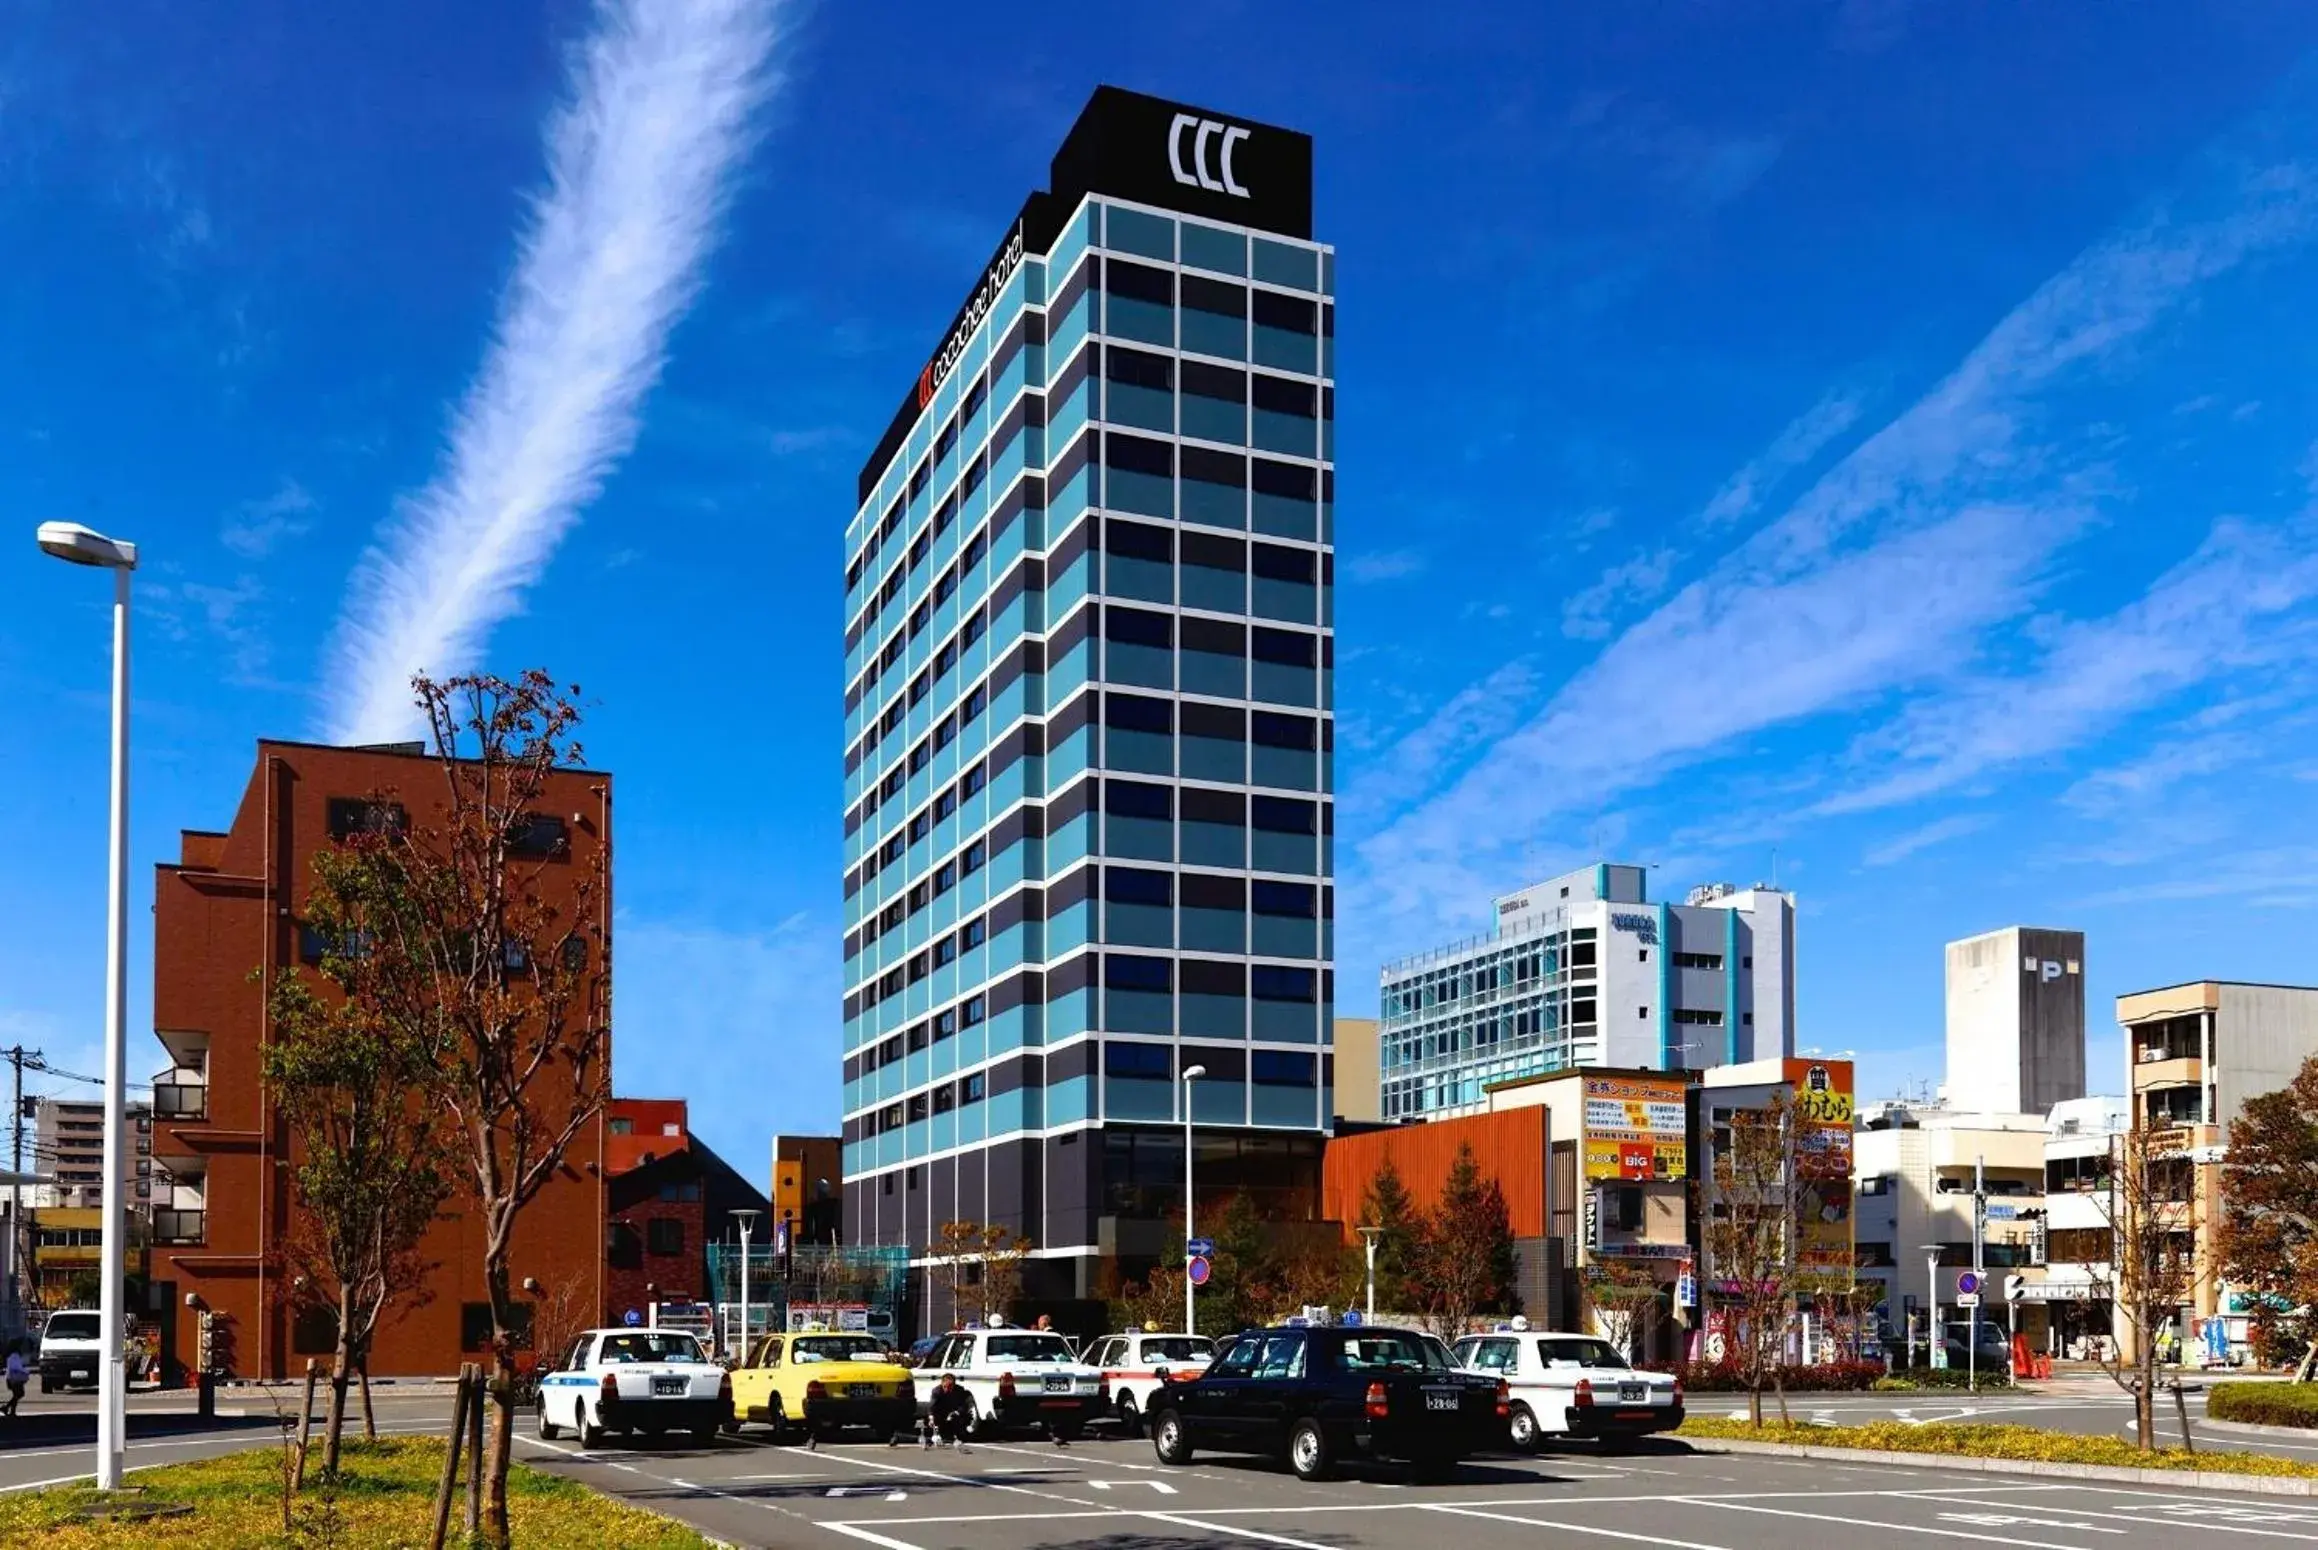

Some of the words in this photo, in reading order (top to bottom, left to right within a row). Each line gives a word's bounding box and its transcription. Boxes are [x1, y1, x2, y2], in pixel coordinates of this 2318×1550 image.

[1168, 112, 1251, 199] CCC
[933, 287, 988, 387] cocochee
[988, 217, 1024, 301] hotel
[2042, 960, 2062, 983] P
[1625, 1153, 1648, 1167] BIG
